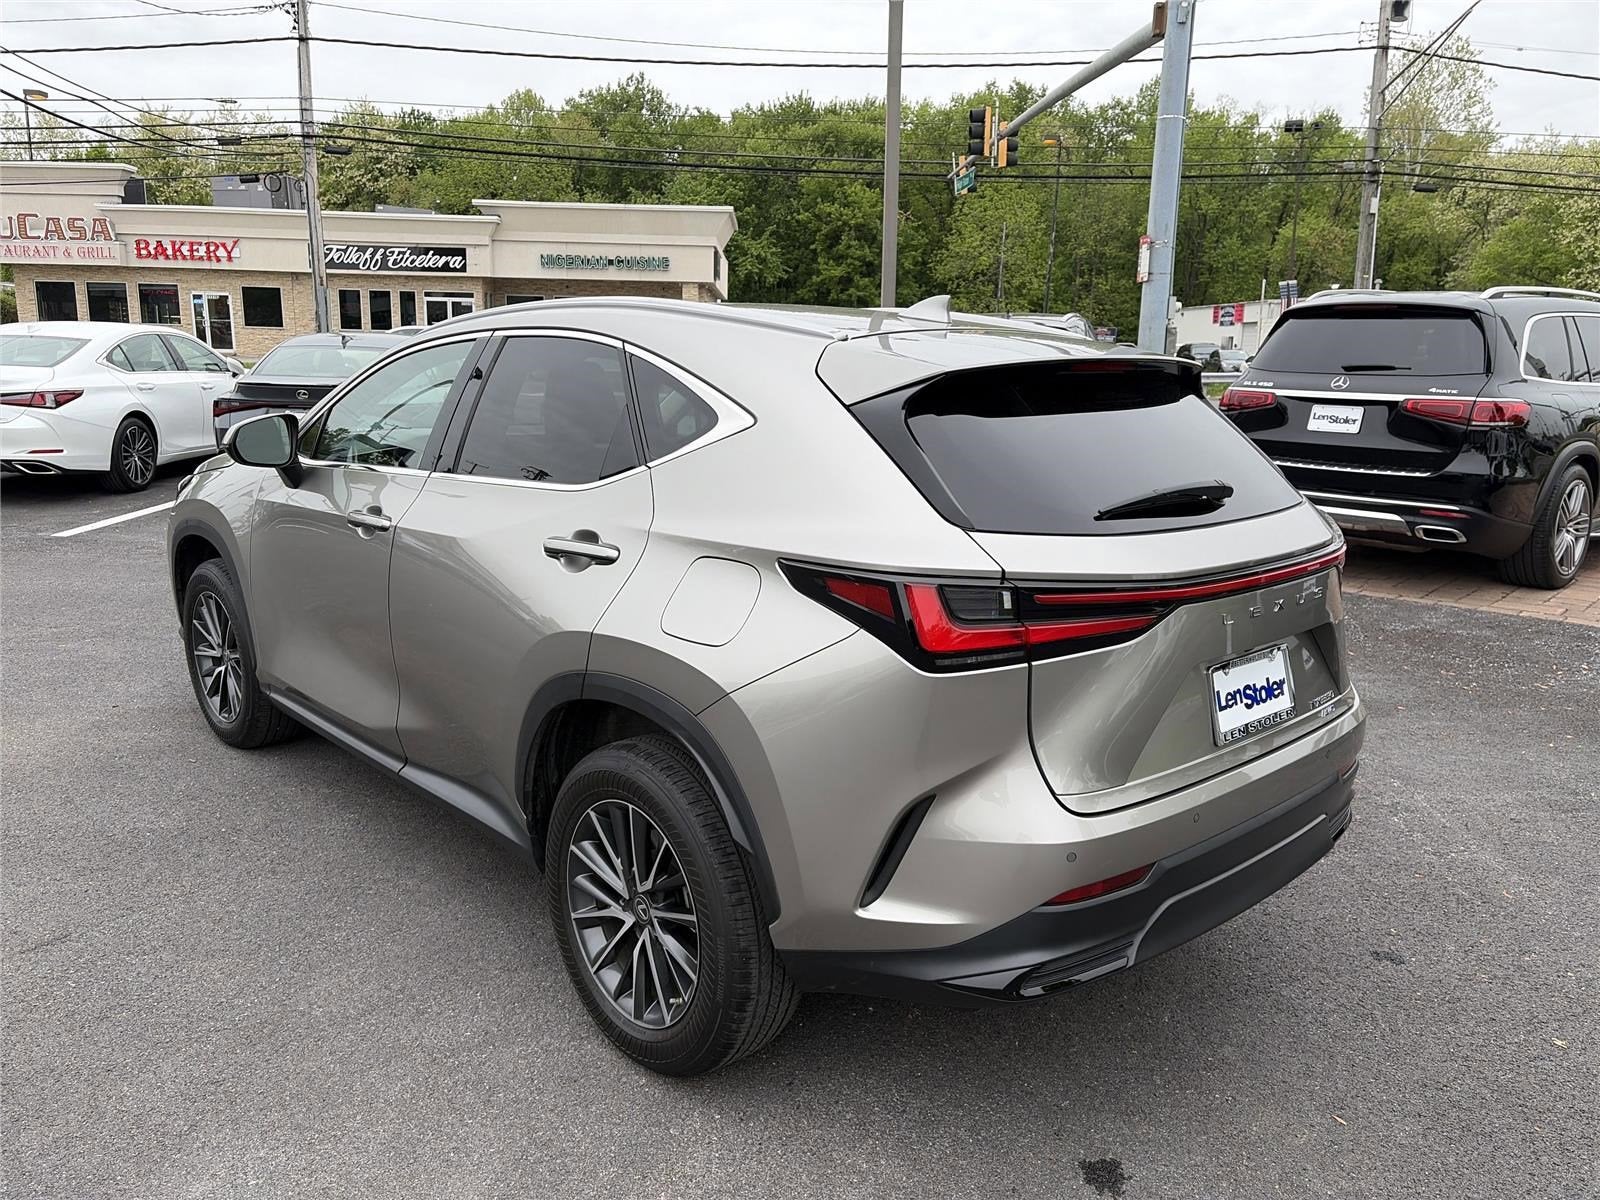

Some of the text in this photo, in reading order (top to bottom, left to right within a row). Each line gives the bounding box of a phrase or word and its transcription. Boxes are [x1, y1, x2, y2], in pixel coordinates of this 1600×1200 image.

[0, 244, 115, 259] AURANT & GRILL
[135, 238, 240, 263] BAKERY
[386, 247, 466, 269] Etcetera
[540, 254, 670, 271] NIGERIAN CUISINE
[1222, 586, 1323, 625] LEXUS
[1223, 708, 1295, 743] LEN STOLER
